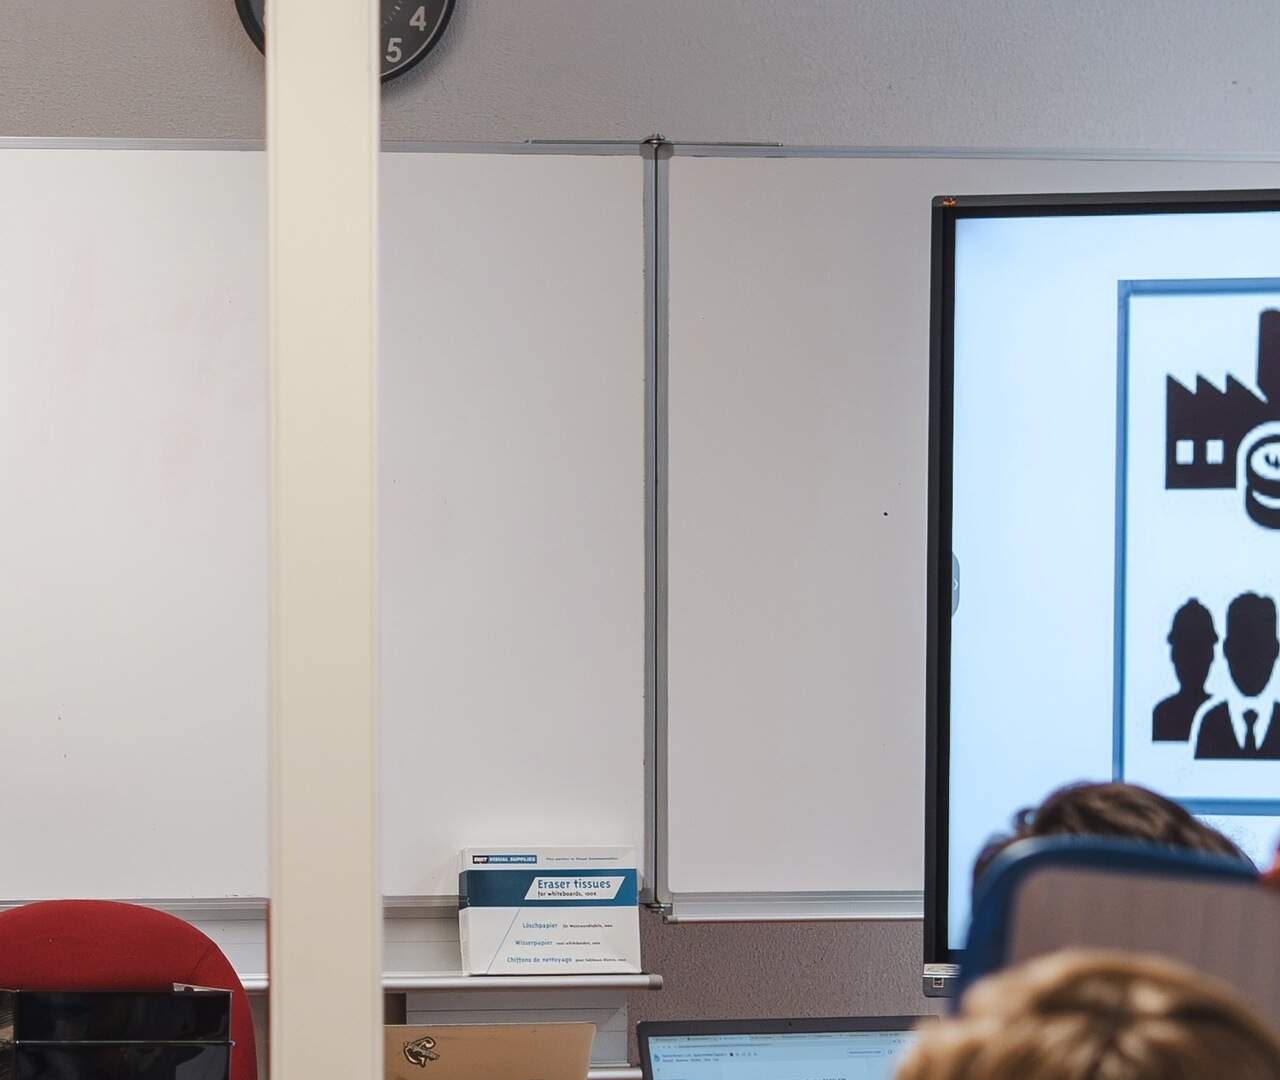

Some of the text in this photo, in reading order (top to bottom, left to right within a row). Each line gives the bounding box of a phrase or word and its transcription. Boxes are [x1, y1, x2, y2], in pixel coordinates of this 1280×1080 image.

[408, 6, 427, 31] 4
[385, 37, 403, 63] 5
[537, 878, 611, 889] Eraser tissues
